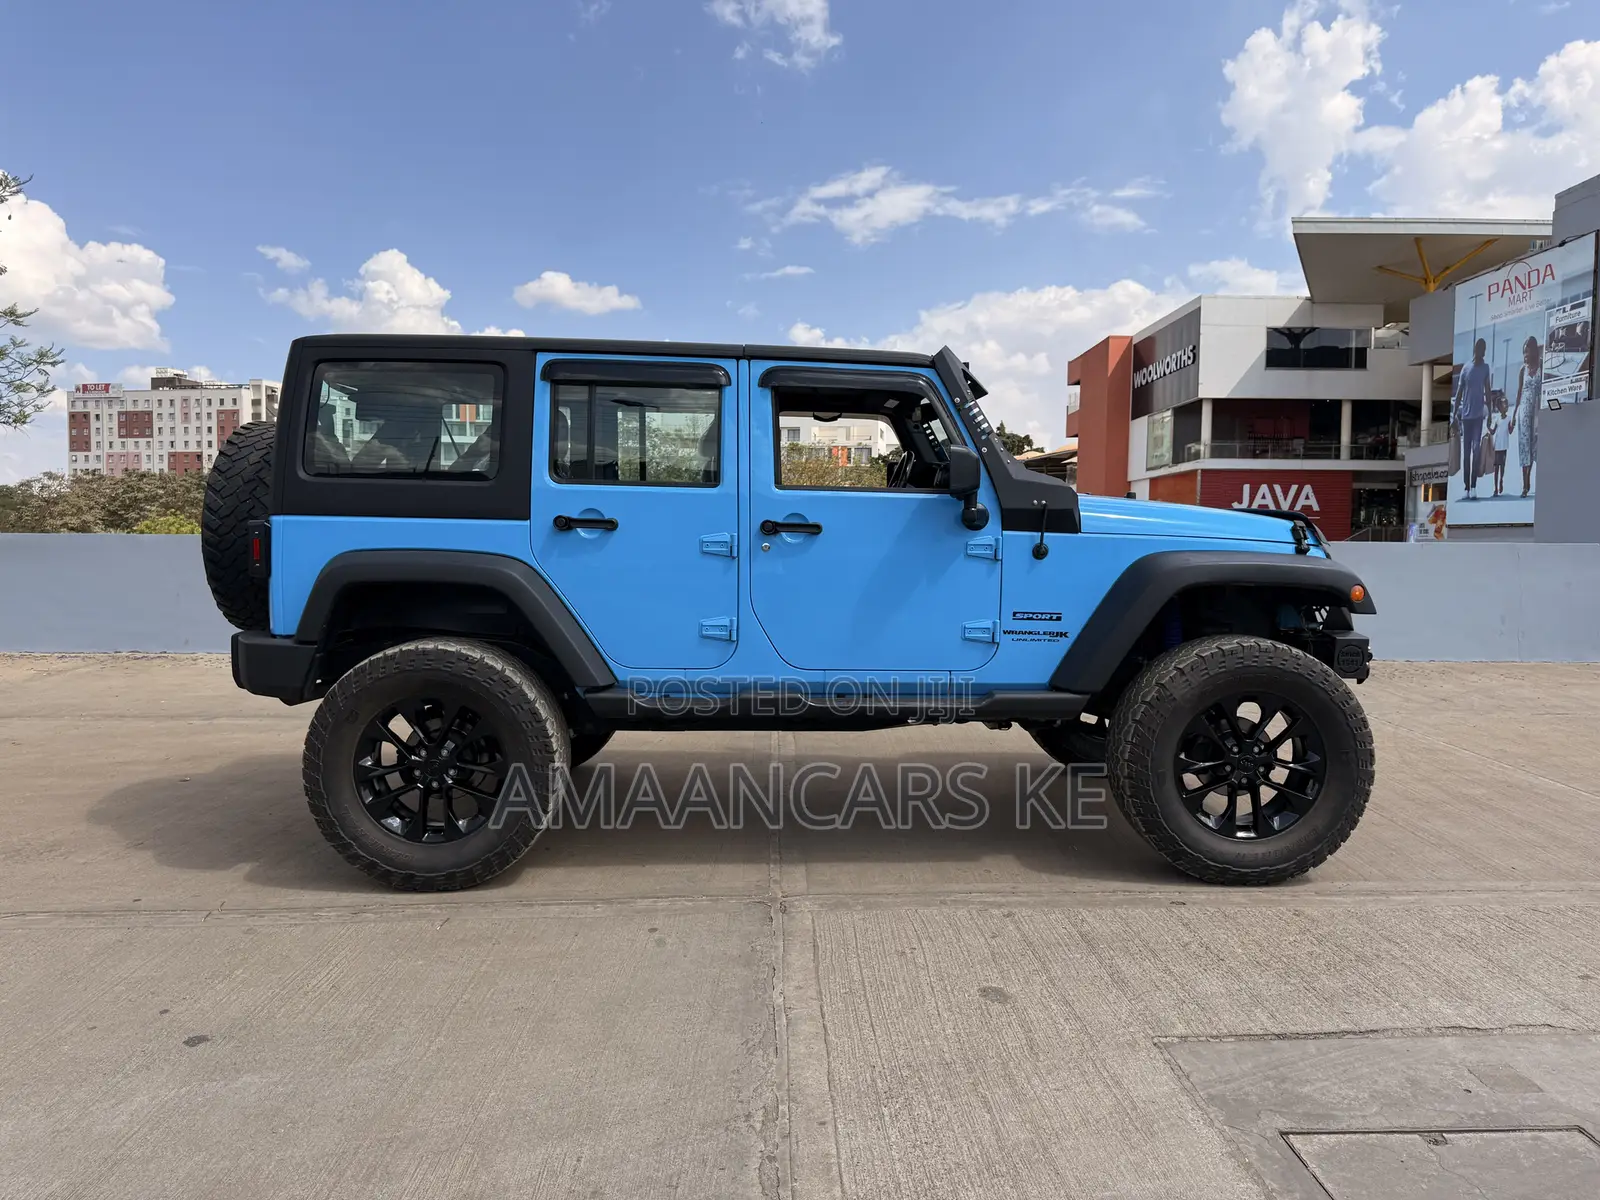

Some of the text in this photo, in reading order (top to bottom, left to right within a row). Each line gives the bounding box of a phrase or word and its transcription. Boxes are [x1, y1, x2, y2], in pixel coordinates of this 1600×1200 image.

[1487, 263, 1556, 302] PANDA
[1508, 289, 1534, 308] MART
[1555, 310, 1582, 324] Furniture
[1133, 344, 1195, 389] WOOLWORTHS
[1547, 384, 1583, 396] Kitchen Ware
[1231, 483, 1320, 512] JAVA
[1014, 612, 1060, 620] SPORT
[1002, 629, 1055, 637] WRANGLER
